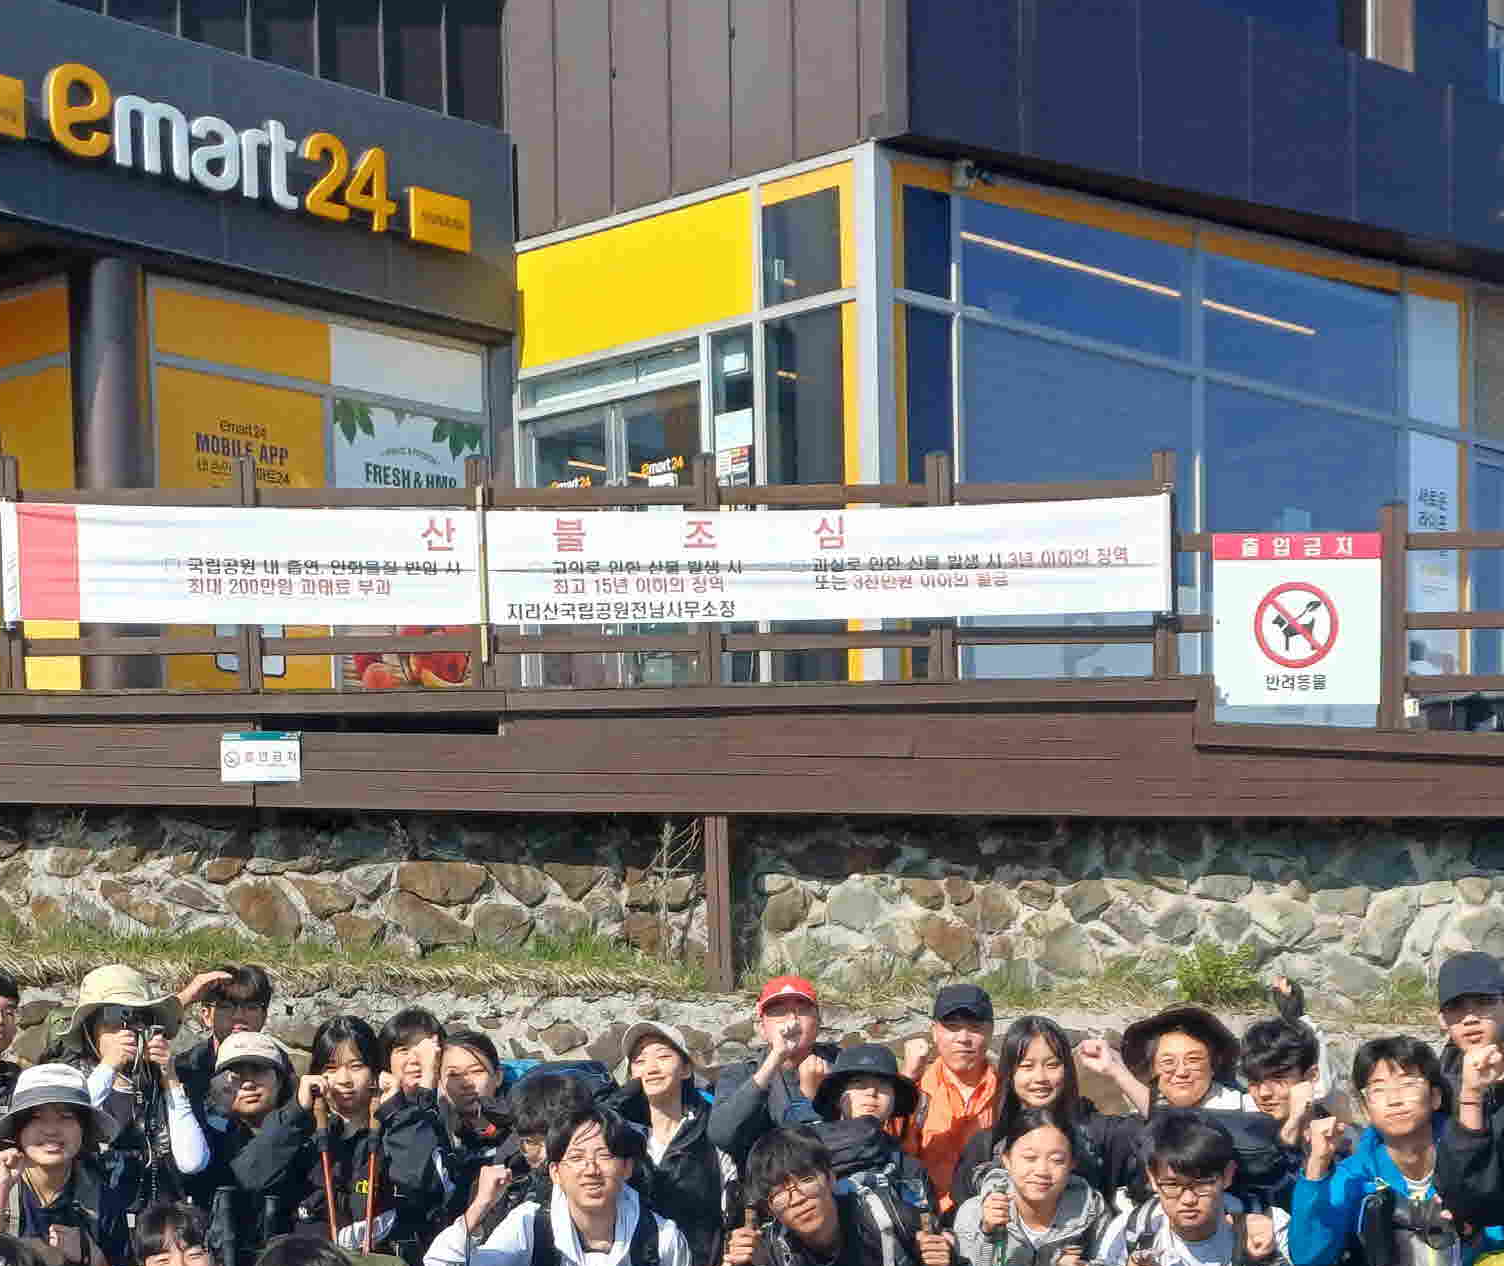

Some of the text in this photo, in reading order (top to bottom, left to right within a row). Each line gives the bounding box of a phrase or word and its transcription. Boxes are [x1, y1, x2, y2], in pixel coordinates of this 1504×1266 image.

[42, 63, 397, 232] emart24
[195, 431, 289, 467] MOBILE APP
[364, 462, 410, 488] FRESH
[421, 515, 845, 552] 산 불 조 심
[1240, 536, 1354, 558] 출입금지
[228, 577, 293, 596] 200만원
[594, 577, 629, 594] 15년
[506, 600, 736, 621] 지리산국립공원전남사무소장
[1264, 673, 1327, 691] 반려동물
